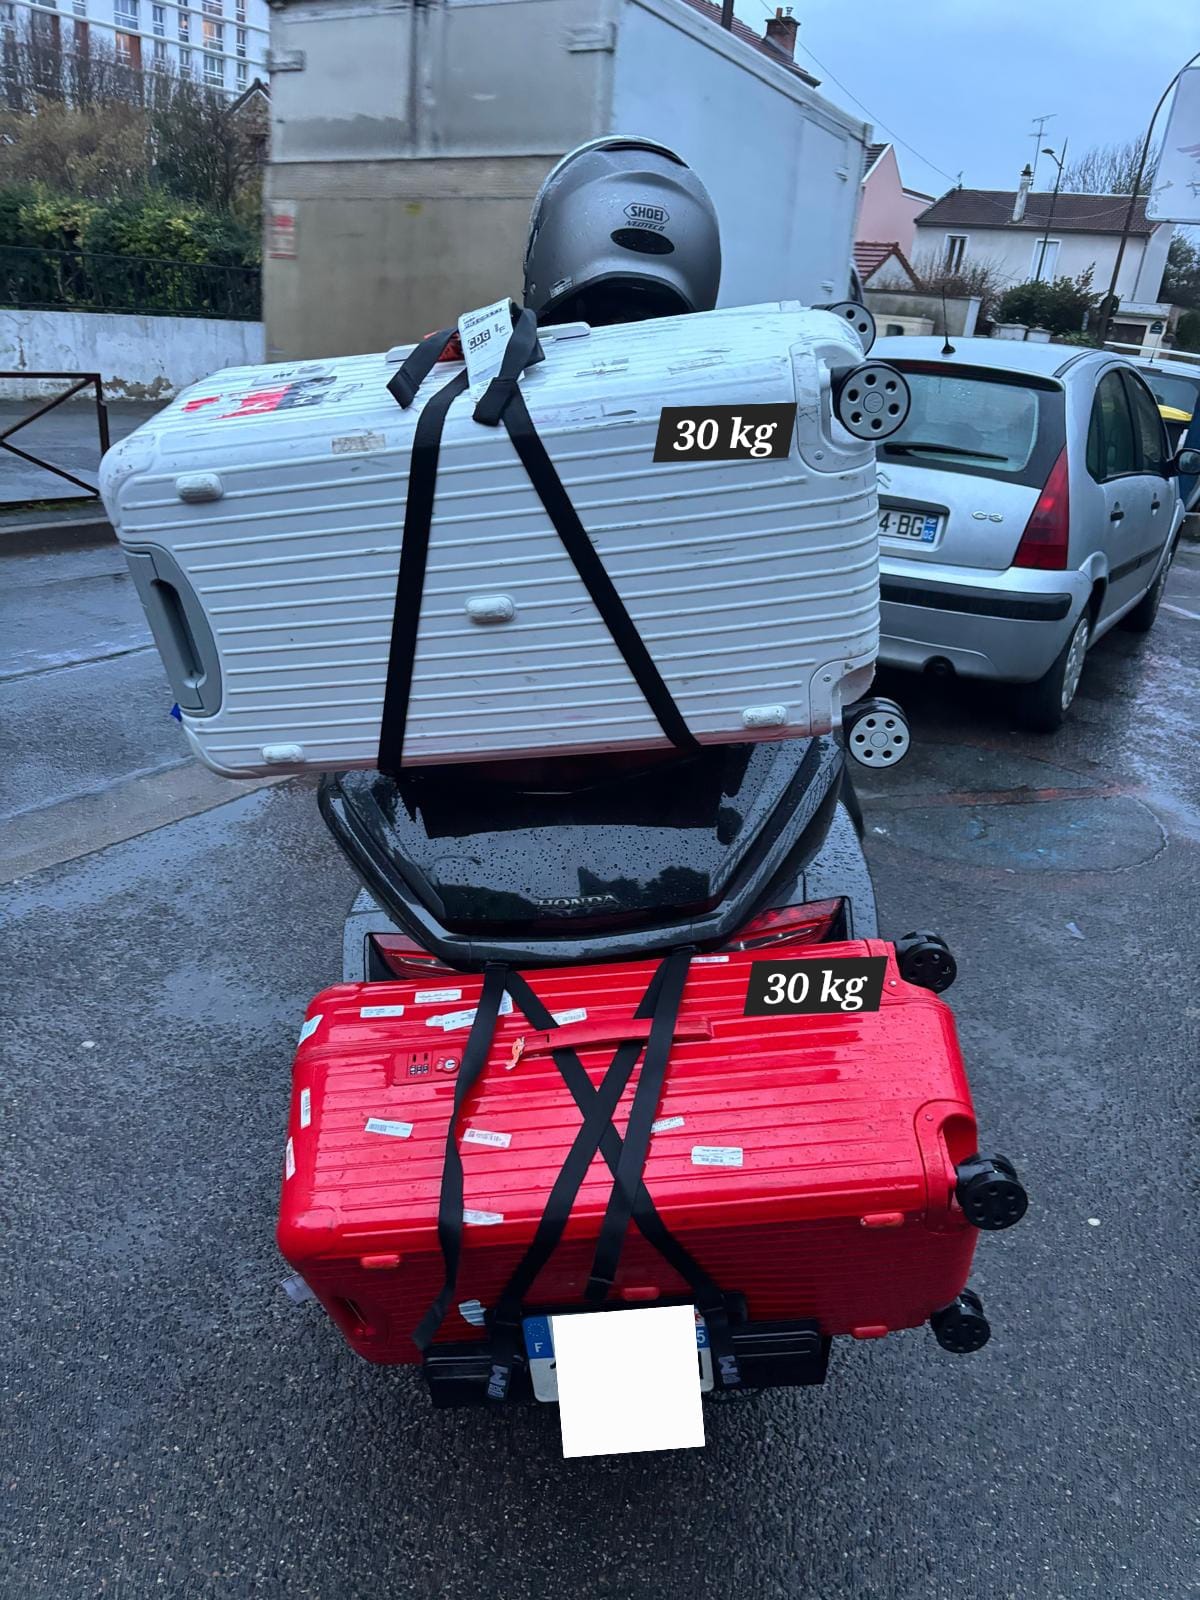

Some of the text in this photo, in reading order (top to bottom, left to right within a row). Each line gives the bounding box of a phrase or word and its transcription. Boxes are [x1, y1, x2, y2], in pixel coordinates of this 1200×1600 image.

[630, 206, 664, 221] SHOEI
[469, 330, 491, 350] CDG
[971, 510, 1003, 523] C3
[538, 895, 619, 905] HONDA
[534, 1341, 544, 1353] F
